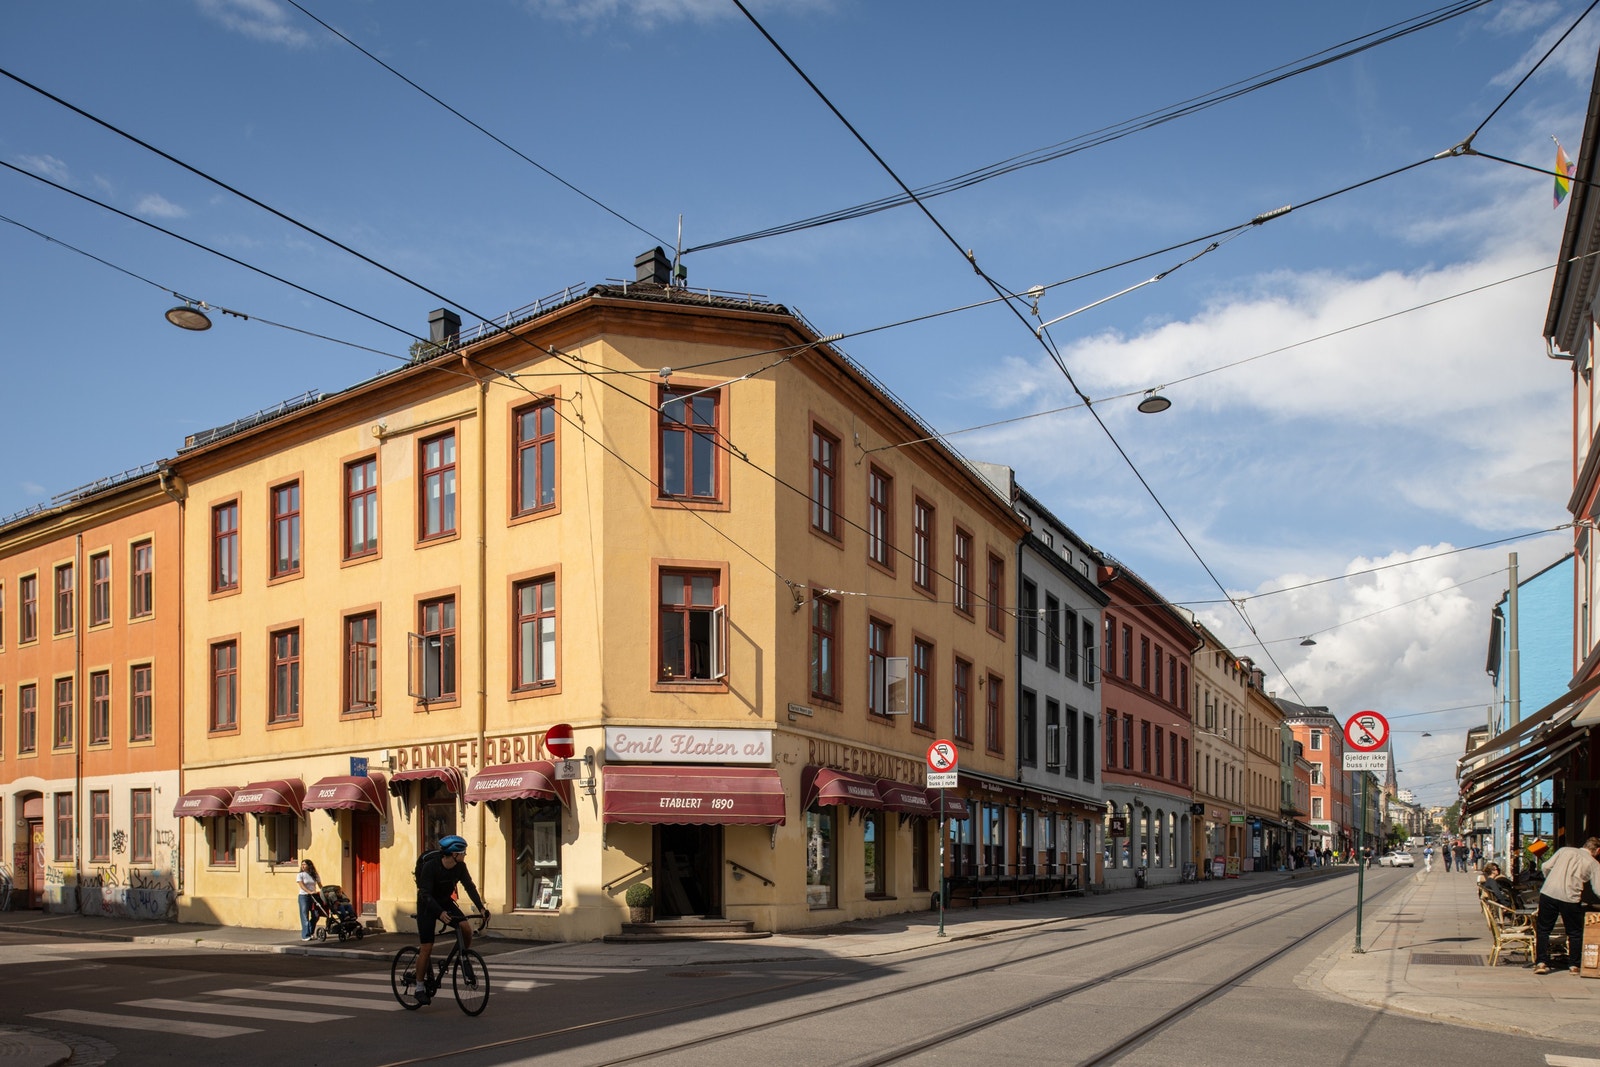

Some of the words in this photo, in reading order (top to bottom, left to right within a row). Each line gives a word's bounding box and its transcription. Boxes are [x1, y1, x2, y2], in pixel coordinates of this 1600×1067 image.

[397, 733, 555, 771] RAMMEFABRIK
[613, 733, 663, 755] Emil
[670, 734, 738, 756] Flaten
[743, 741, 765, 756] as
[808, 738, 925, 785] RULLEGARDINFABR
[1345, 754, 1370, 762] Gjelder
[474, 776, 524, 790] RULLEGARDINER
[659, 797, 703, 809] ETABLERT
[711, 798, 734, 810] 1890
